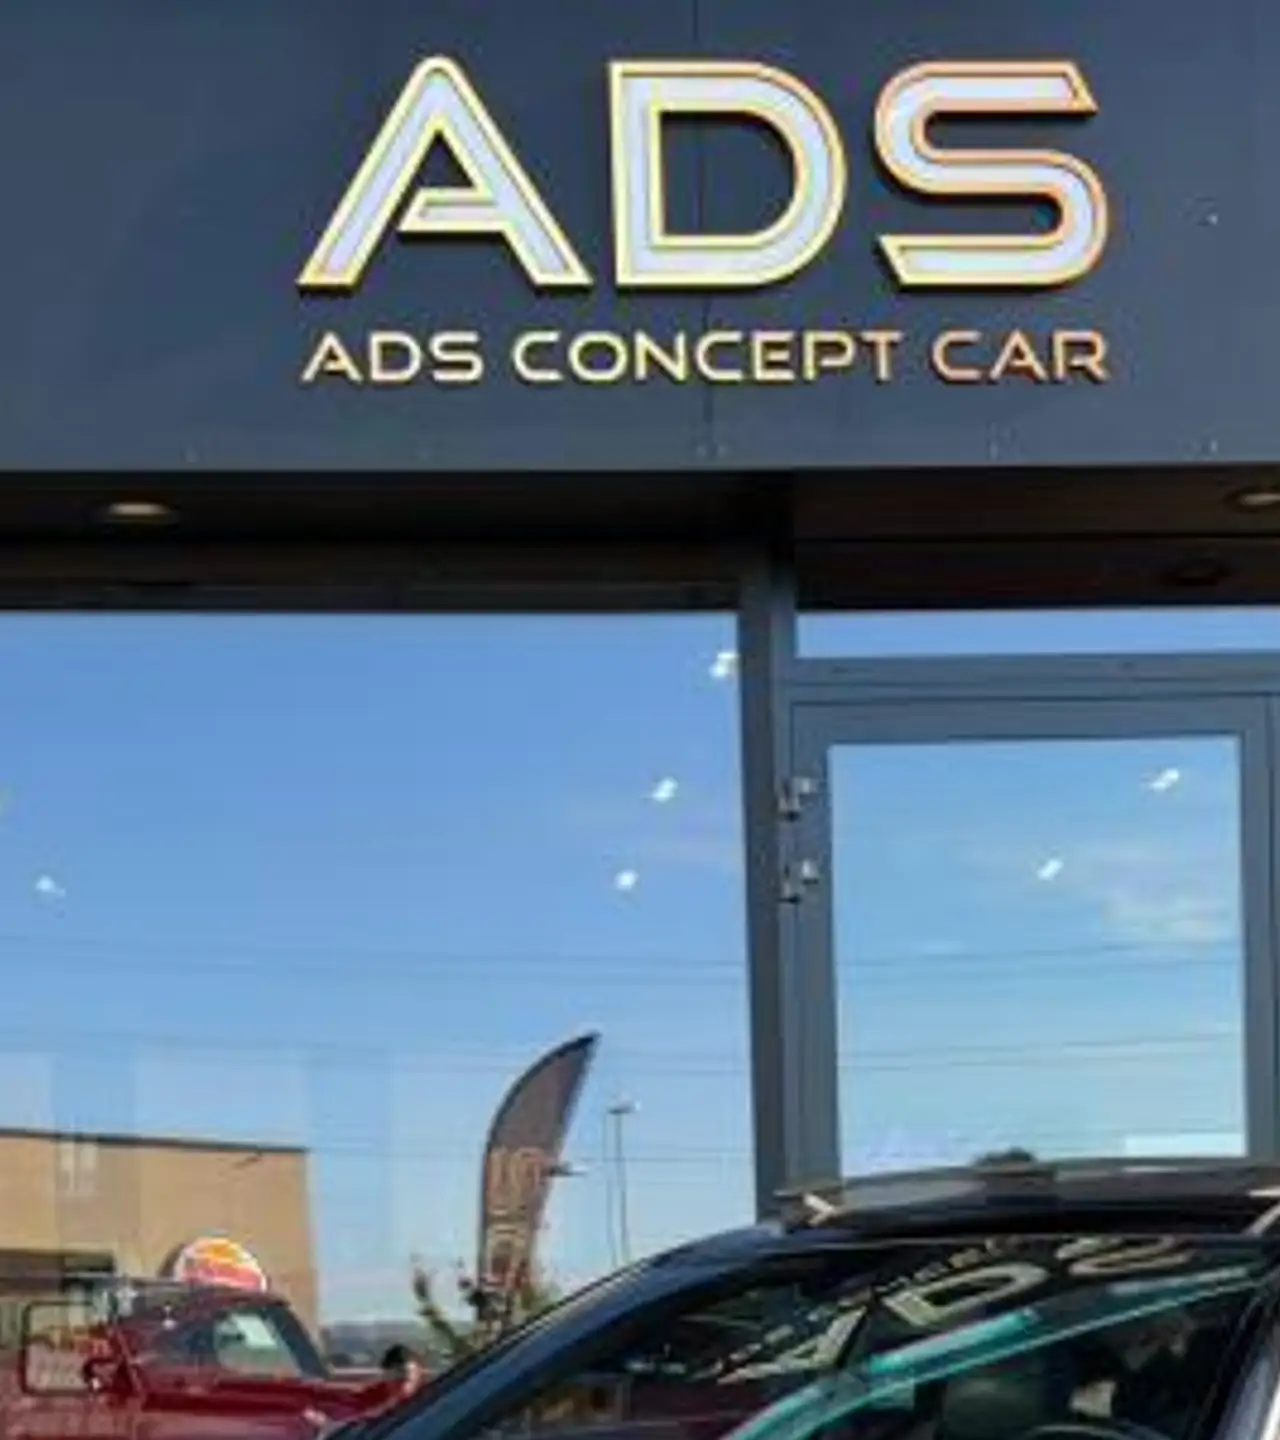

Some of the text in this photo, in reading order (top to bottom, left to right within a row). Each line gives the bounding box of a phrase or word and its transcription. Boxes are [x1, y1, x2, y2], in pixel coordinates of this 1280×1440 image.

[295, 53, 1109, 289] ADS
[300, 328, 1112, 384] ADS CONCEPT CAR
